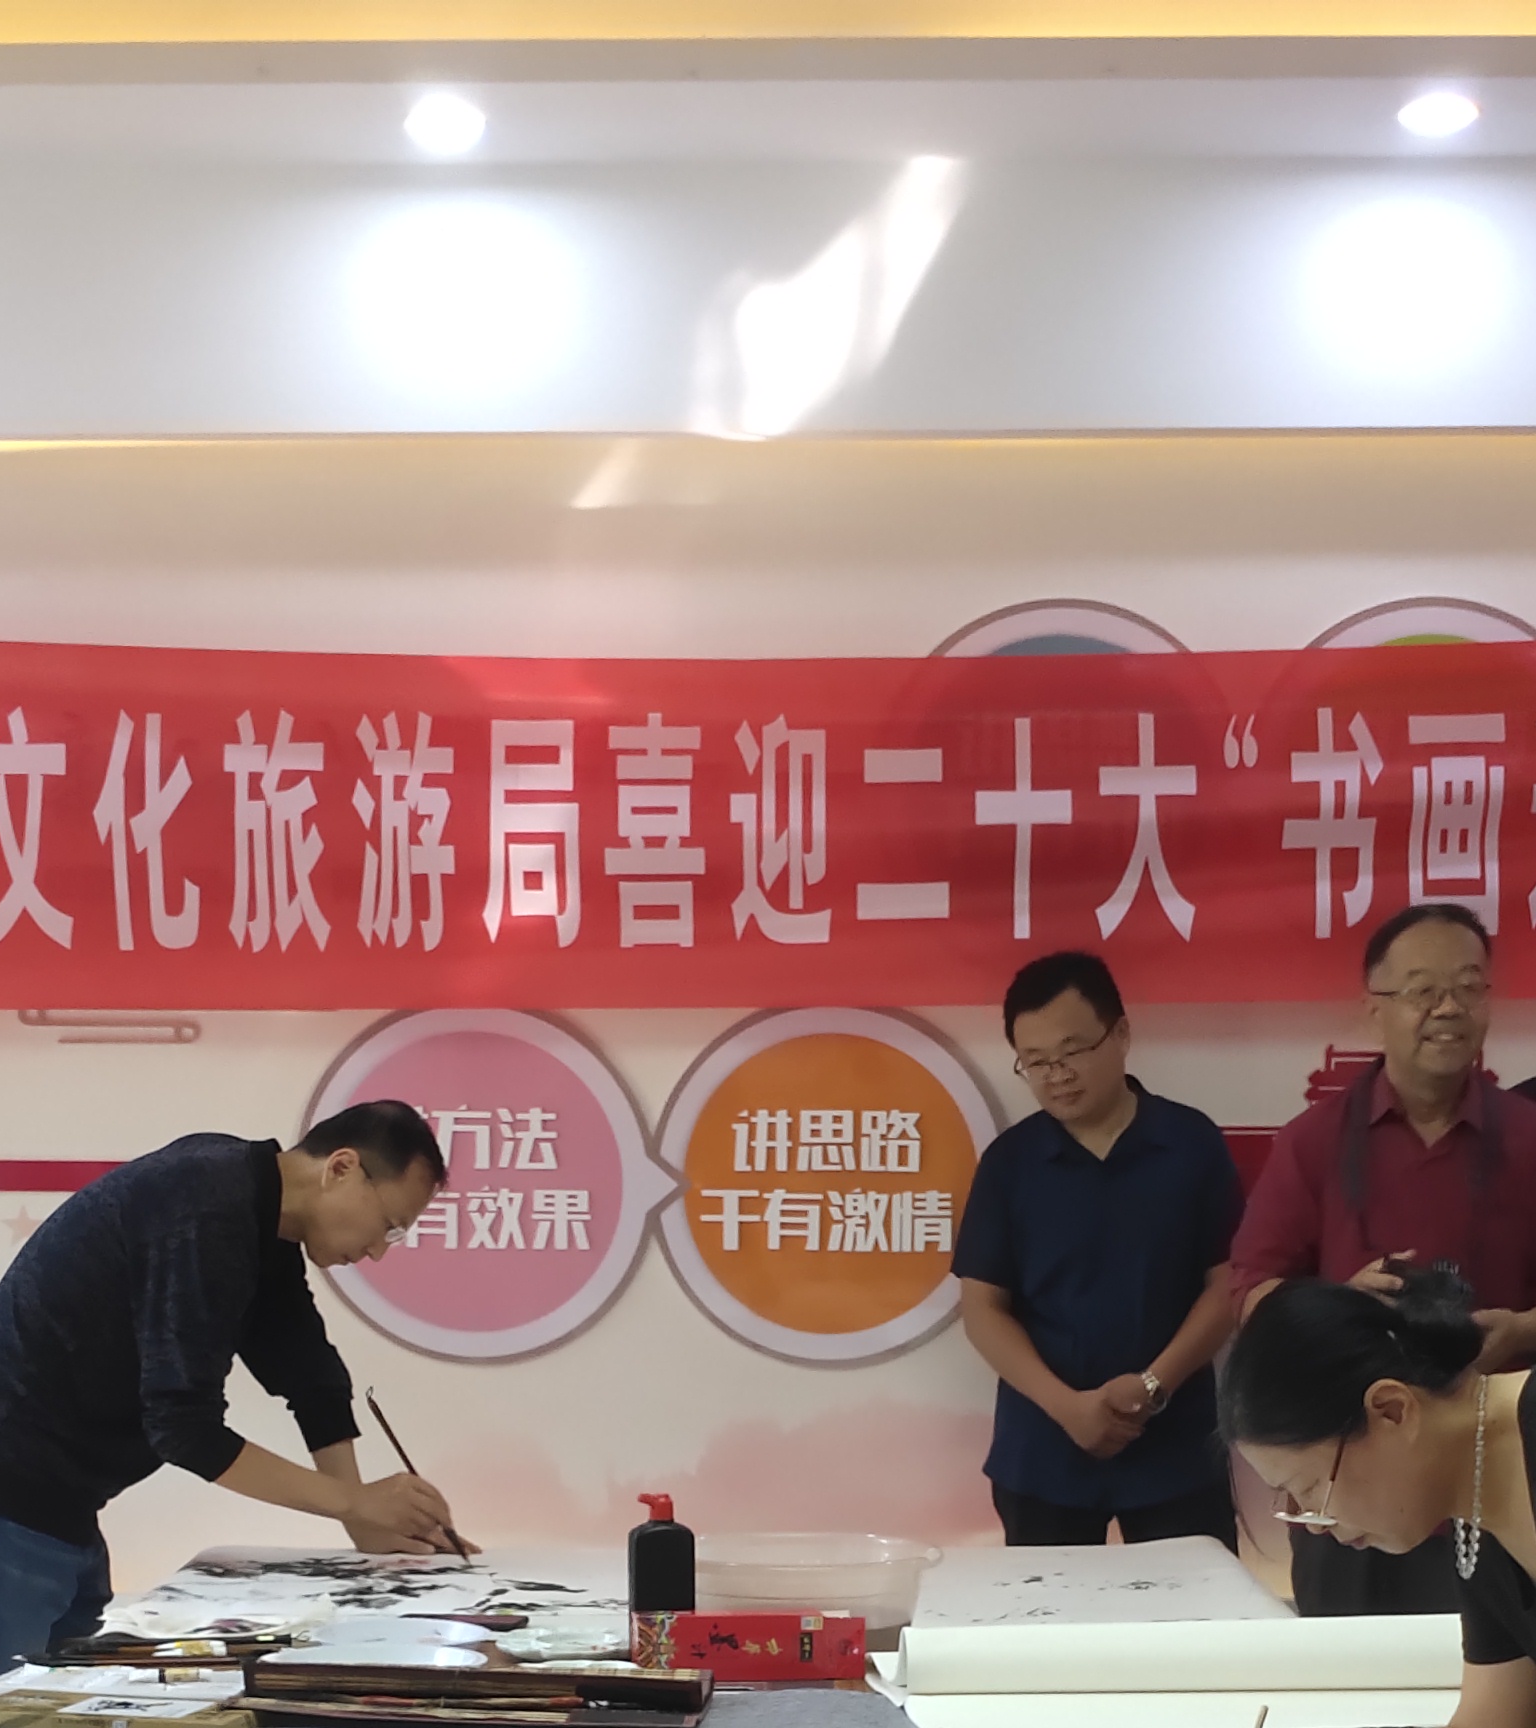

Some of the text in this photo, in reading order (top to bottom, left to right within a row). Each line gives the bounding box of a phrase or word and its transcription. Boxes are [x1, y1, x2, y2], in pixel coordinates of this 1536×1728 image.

[414, 1103, 559, 1170] 方法
[731, 1108, 922, 1173] 讲思路
[699, 1188, 954, 1253] 干有激情
